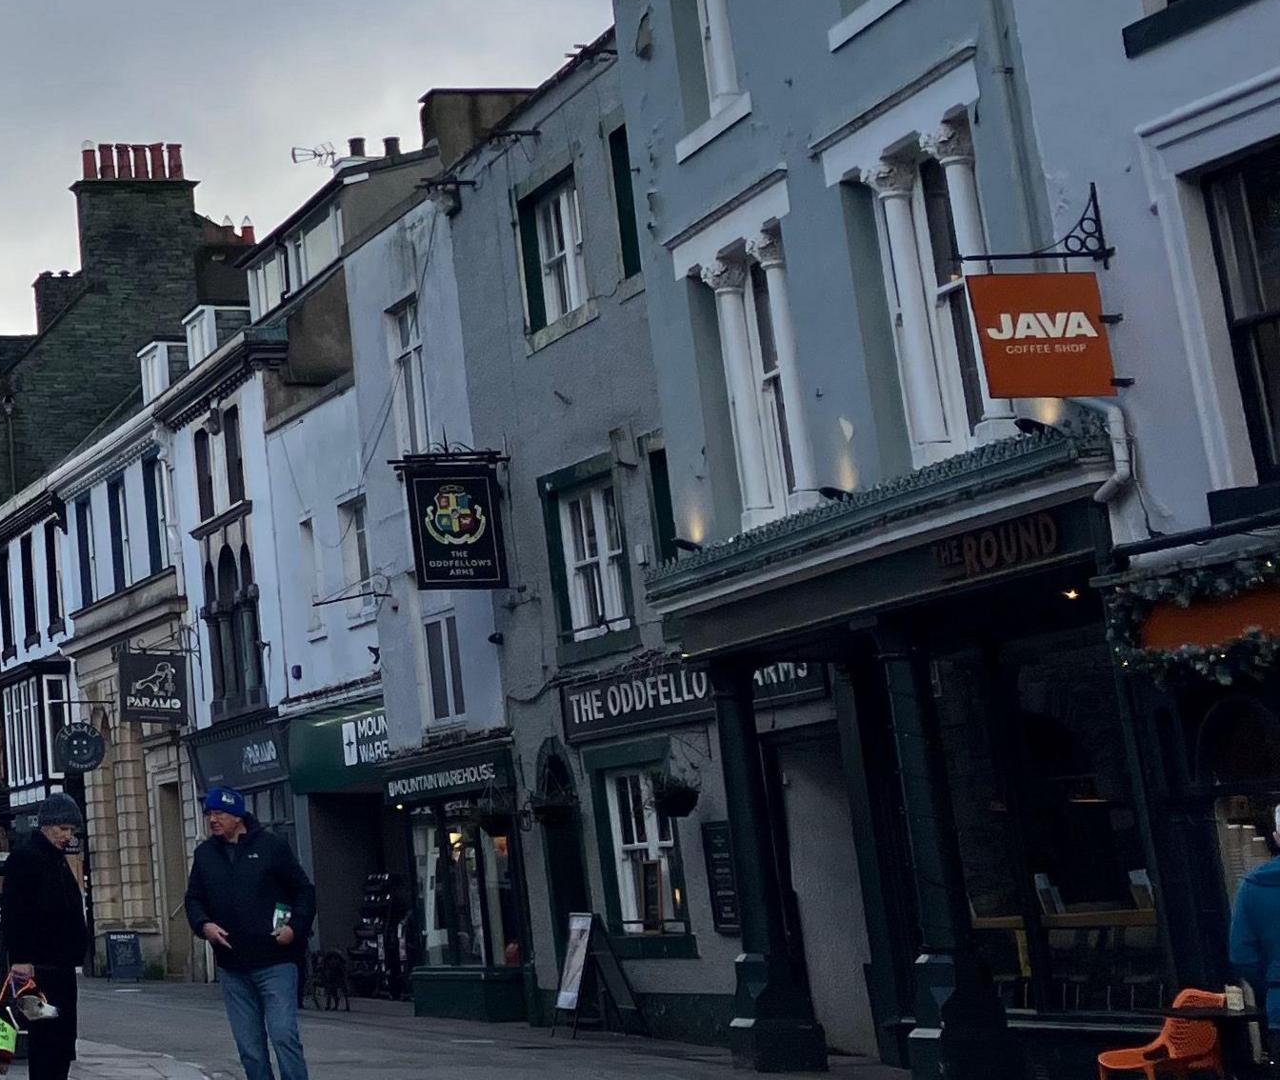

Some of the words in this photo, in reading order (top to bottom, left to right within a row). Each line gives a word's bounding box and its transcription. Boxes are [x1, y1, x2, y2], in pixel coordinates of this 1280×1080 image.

[987, 312, 1098, 339] JAVA
[1006, 344, 1050, 354] COFFEE
[1054, 344, 1086, 353] SHOP
[963, 513, 1057, 577] ROUND
[569, 689, 604, 724] THE
[606, 670, 708, 716] ODDFELLO
[357, 716, 388, 738] MOUN
[359, 740, 389, 762] WARE
[394, 774, 437, 794] MOUNTAIN
[437, 763, 496, 788] WAREHOUSE
